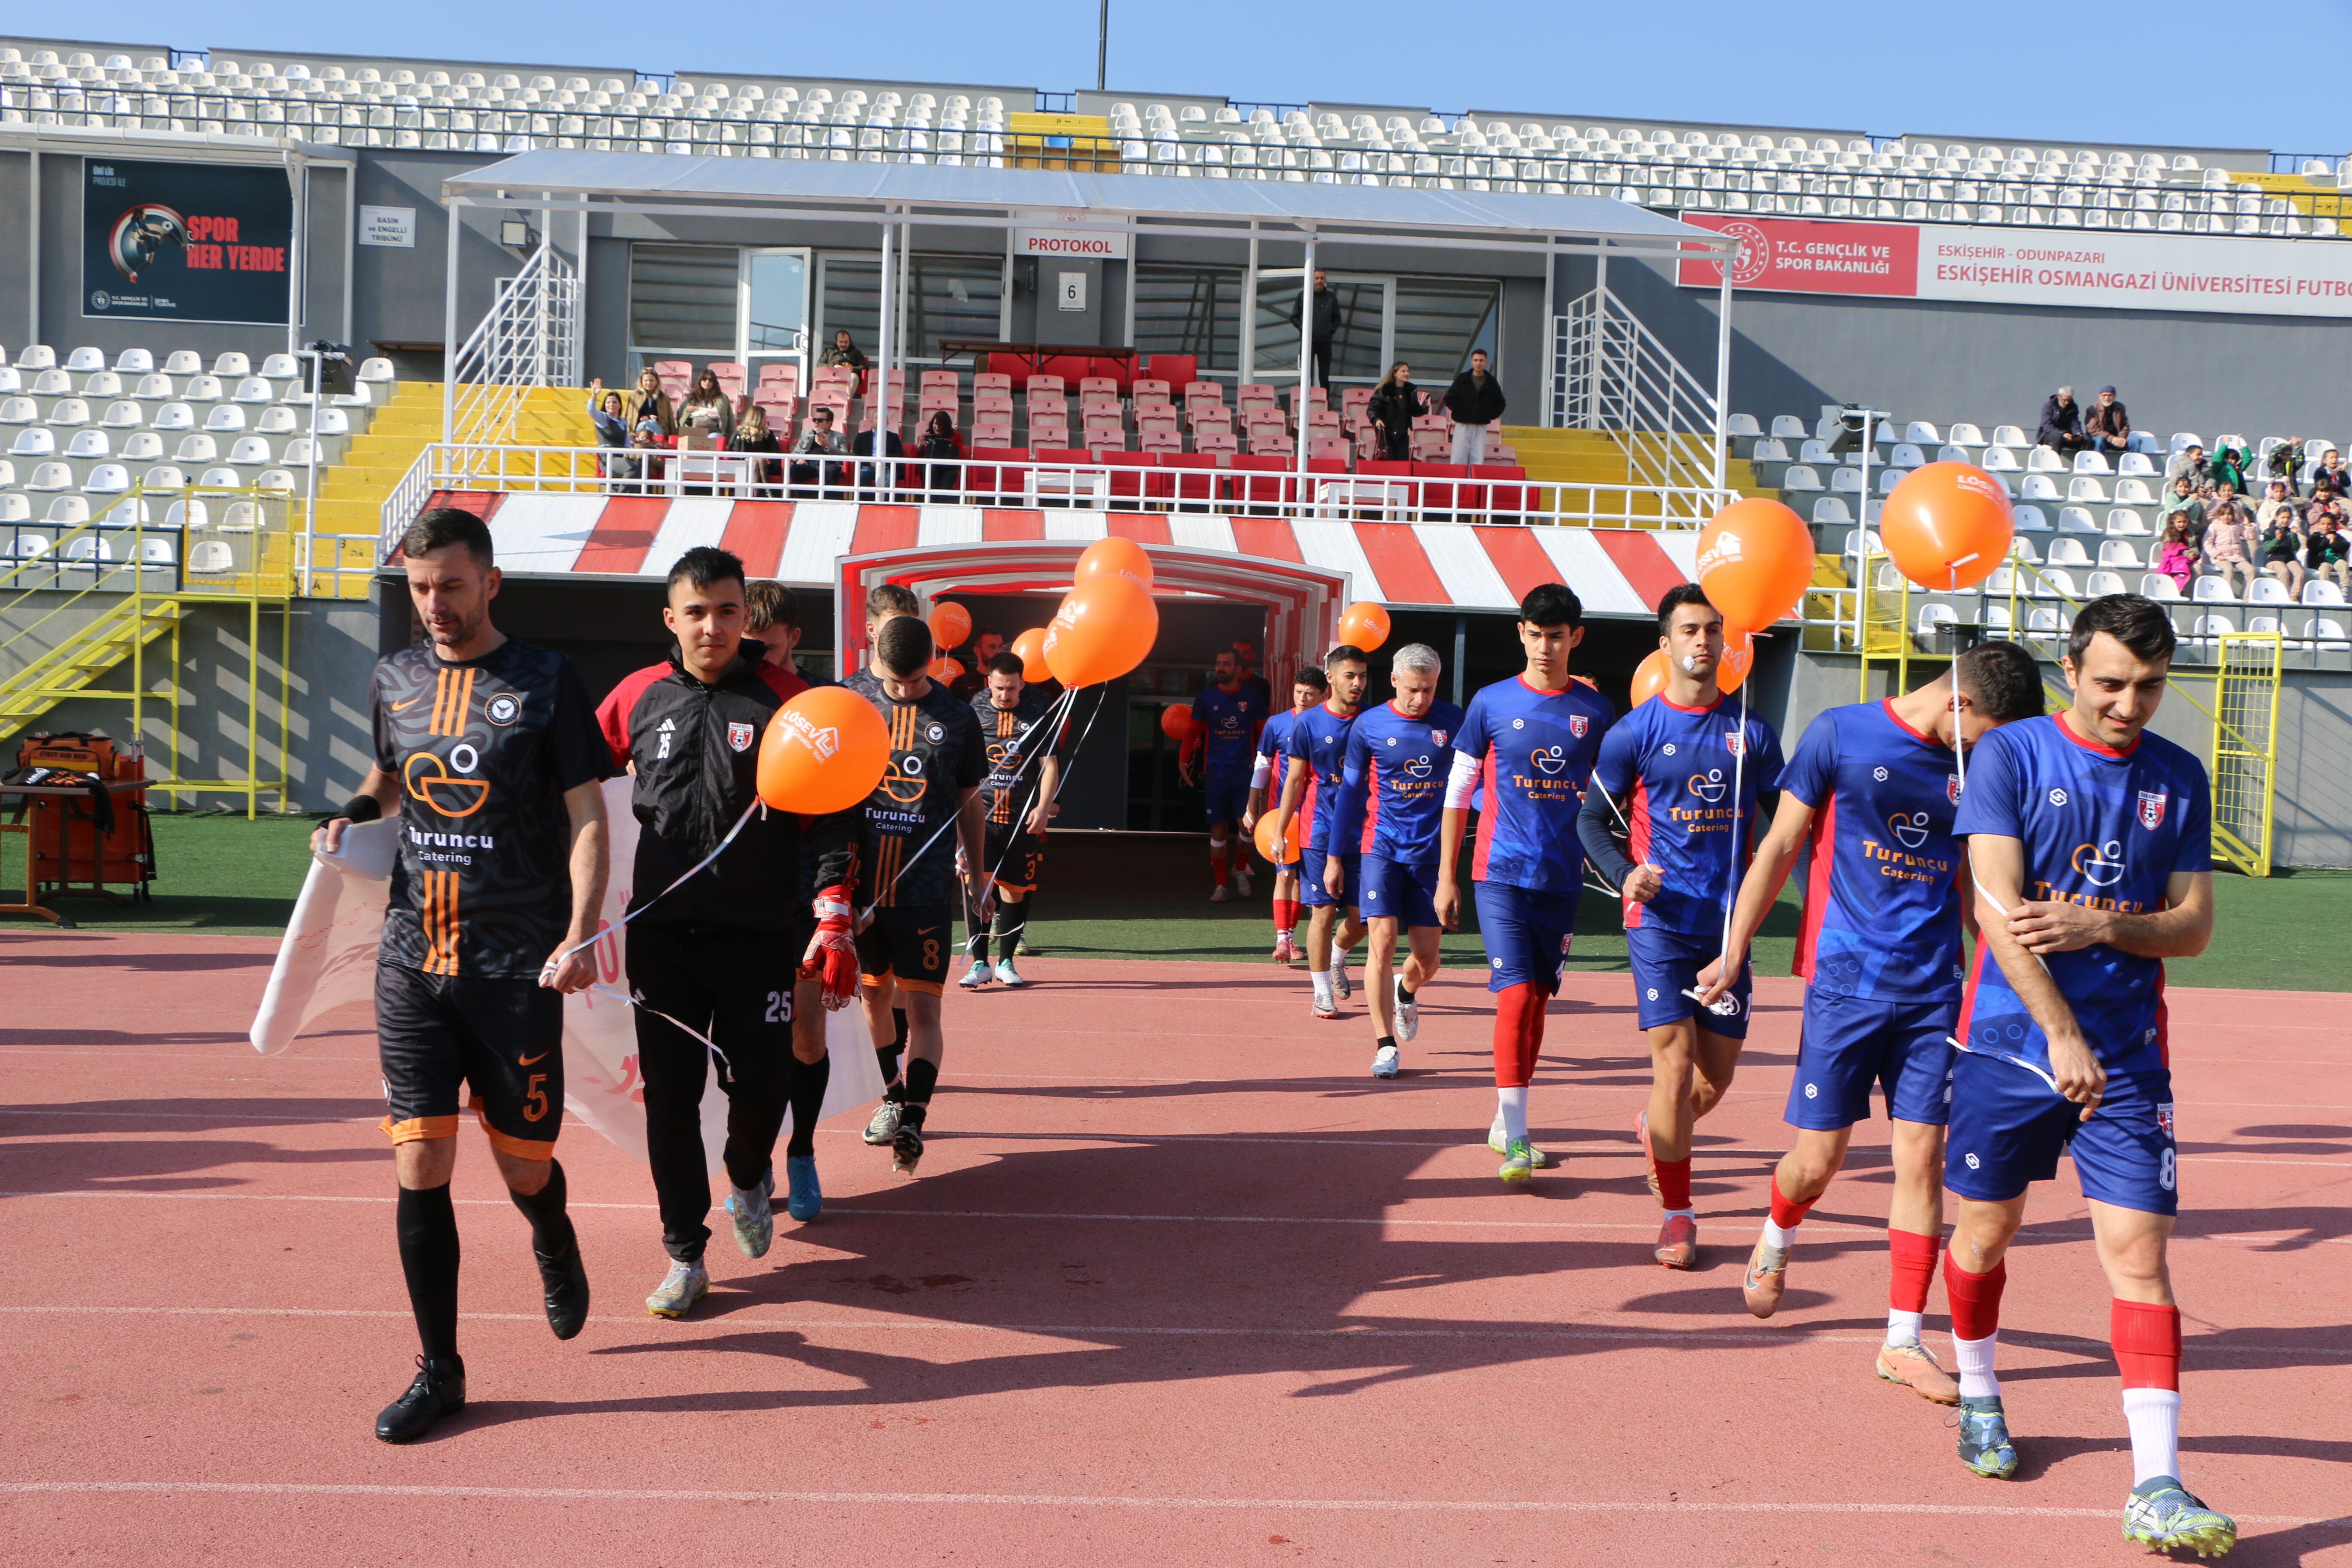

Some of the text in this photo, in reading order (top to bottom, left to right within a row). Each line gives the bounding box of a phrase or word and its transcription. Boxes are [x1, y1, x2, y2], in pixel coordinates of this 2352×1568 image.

[187, 215, 239, 242] SPOR
[371, 234, 403, 242] TRİBÜNÜ
[1029, 238, 1112, 253] PROTOKOL
[1776, 240, 1890, 259] T.C. GENÇLİK VE
[1938, 243, 2006, 261] ESKİŞEHİR
[2016, 248, 2105, 264] ODUNPAZARI
[187, 244, 284, 272] HER YERDE
[1776, 257, 1890, 274] SPOR BAKANLIĞI
[1936, 263, 2033, 286] ESKİŞEHİR
[2038, 269, 2156, 290] OSMANGAZİ
[2162, 271, 2291, 295] ÜNİVERSİTESİ
[1068, 285, 1076, 299] 6
[783, 710, 821, 739] LÖSEV
[657, 732, 671, 759] 25
[1390, 780, 1443, 790] Turuncu
[1528, 791, 1565, 801] Catering
[865, 808, 925, 823] Turuncu
[1669, 807, 1743, 821] Turuncu
[876, 822, 912, 833] Catering
[1687, 824, 1728, 833] Catering
[418, 850, 472, 865] Catering
[1863, 840, 1948, 872] Turuncu
[1024, 860, 1036, 880] 3
[1881, 866, 1934, 885] Catering
[923, 939, 939, 970] 8
[765, 991, 791, 1022] 25
[522, 1073, 548, 1122] 5
[2160, 1148, 2175, 1191] 8
